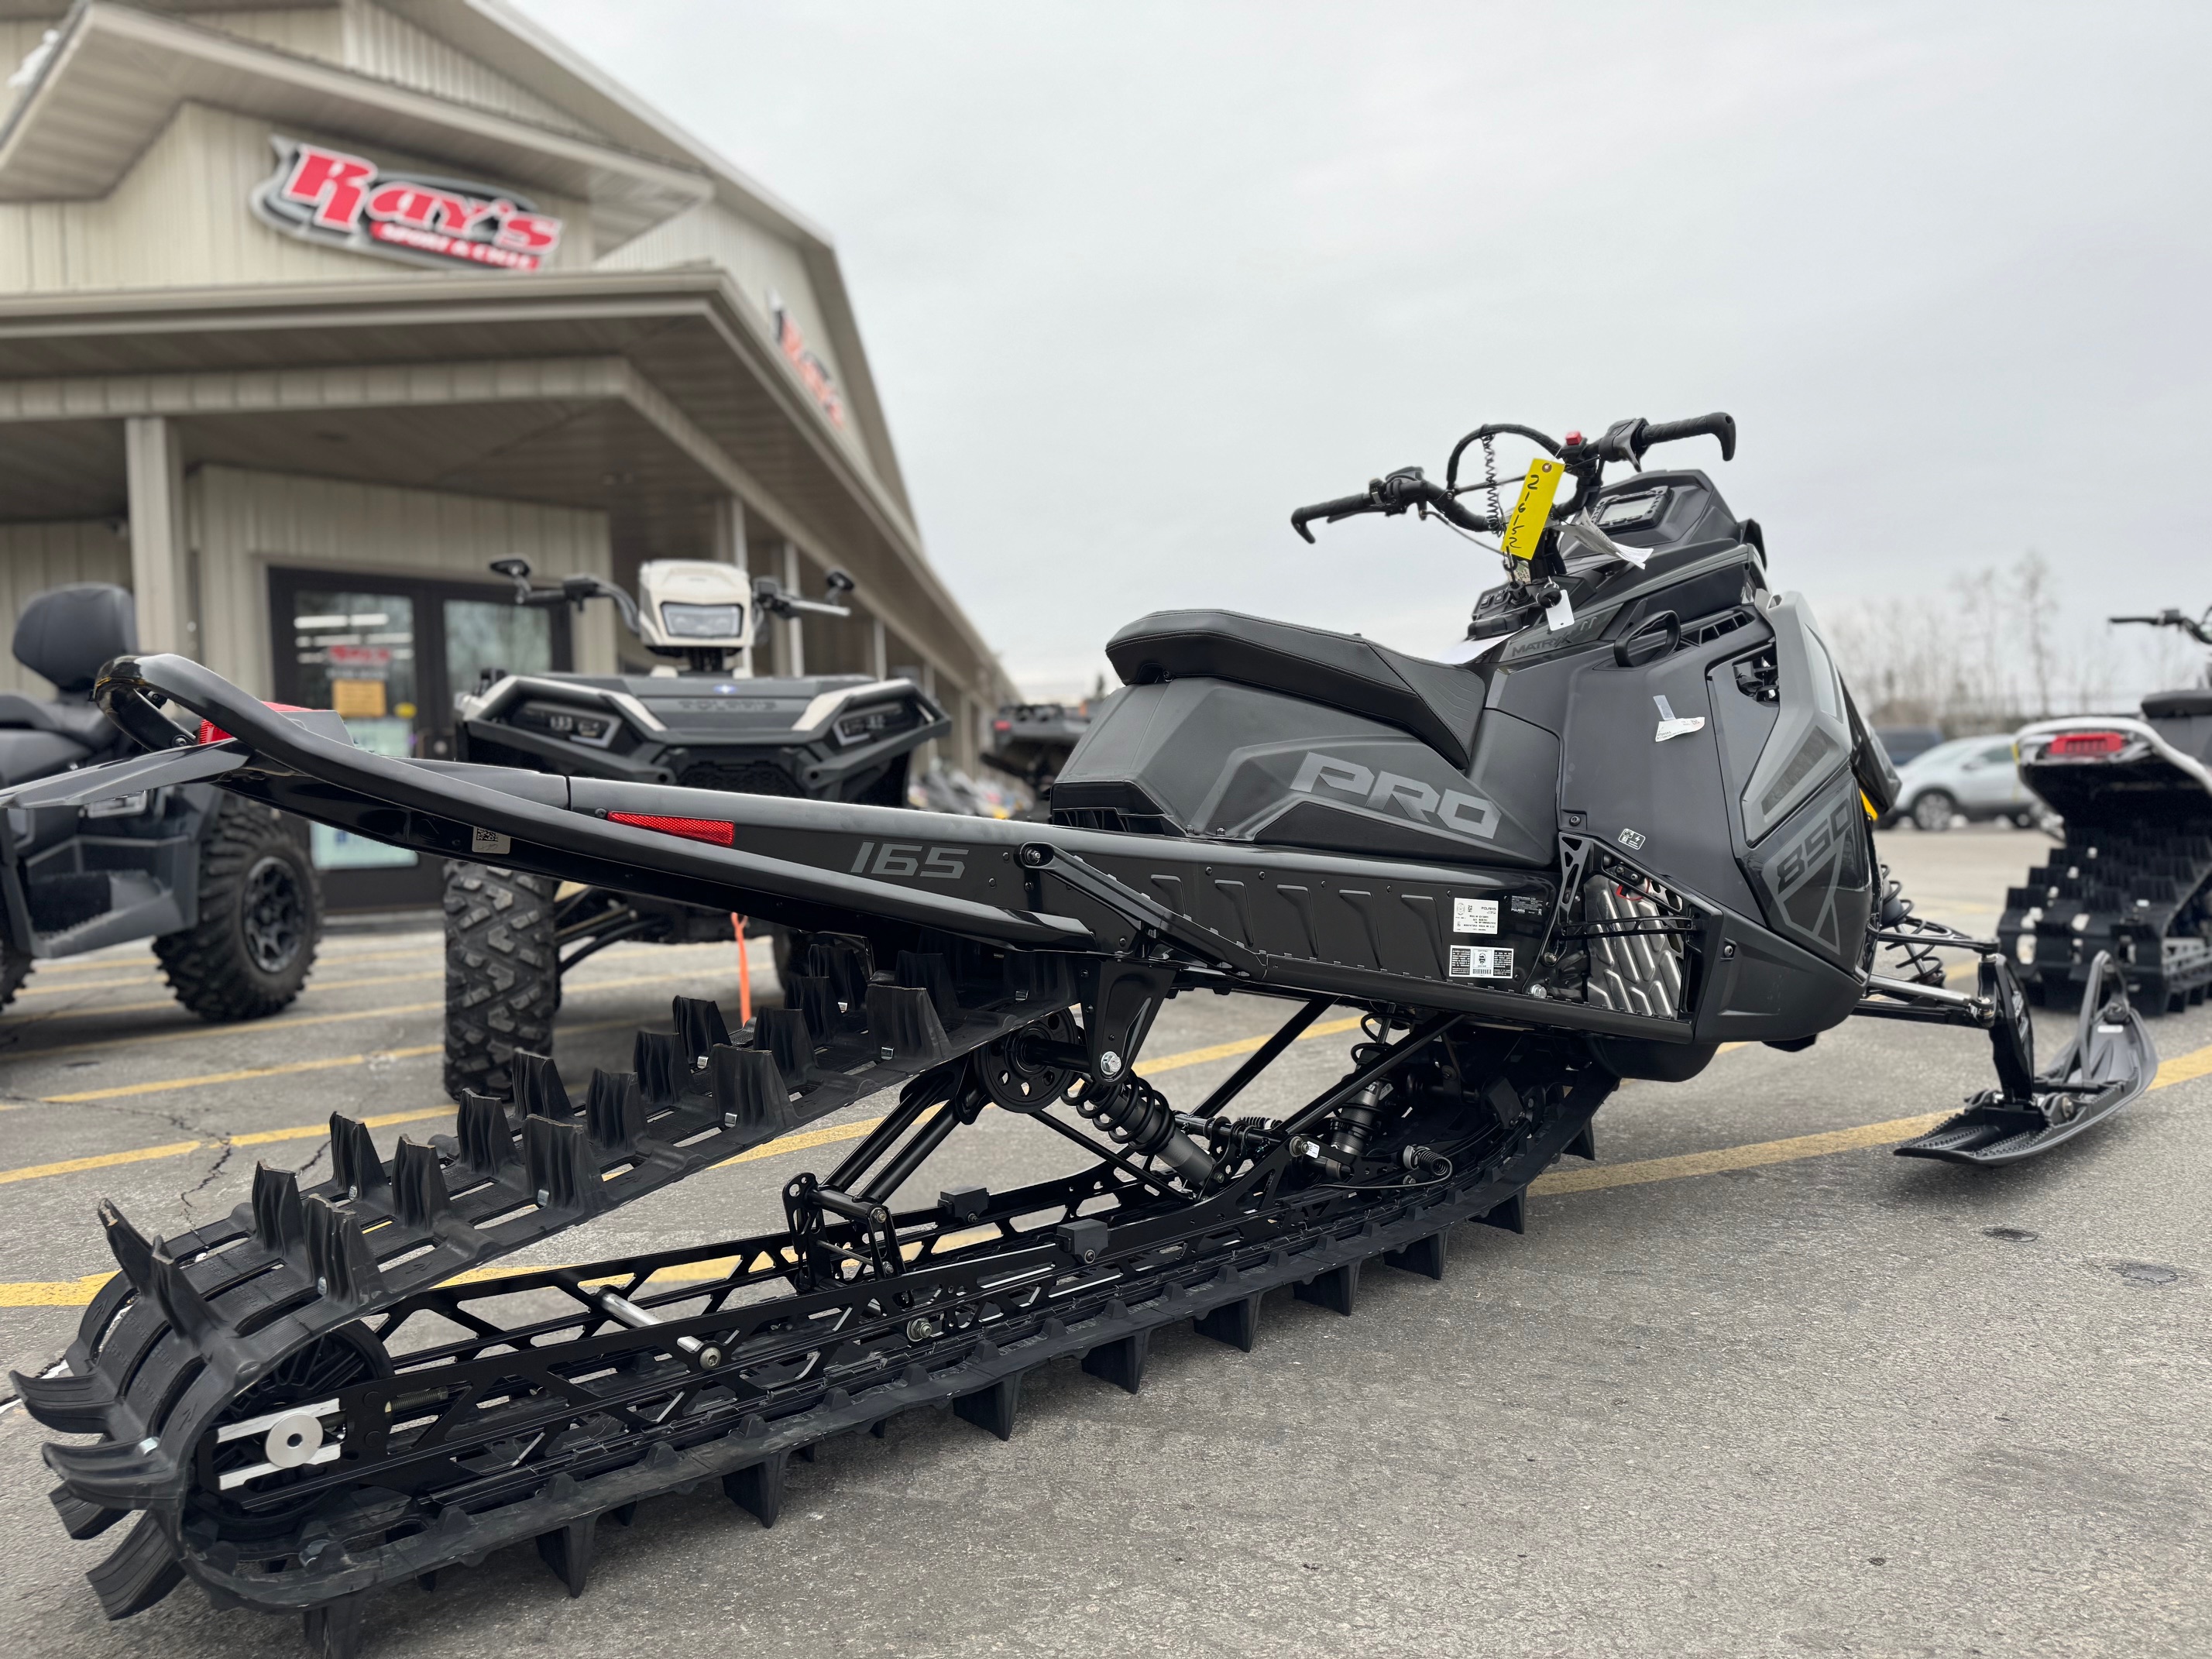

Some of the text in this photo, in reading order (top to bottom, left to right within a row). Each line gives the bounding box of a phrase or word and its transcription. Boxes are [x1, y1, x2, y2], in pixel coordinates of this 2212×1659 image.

[283, 144, 560, 255] Ray's
[1511, 630, 1572, 658] MATRYX
[1290, 750, 1503, 840] PRO
[850, 841, 969, 879] 165
[1777, 797, 1854, 895] 850
